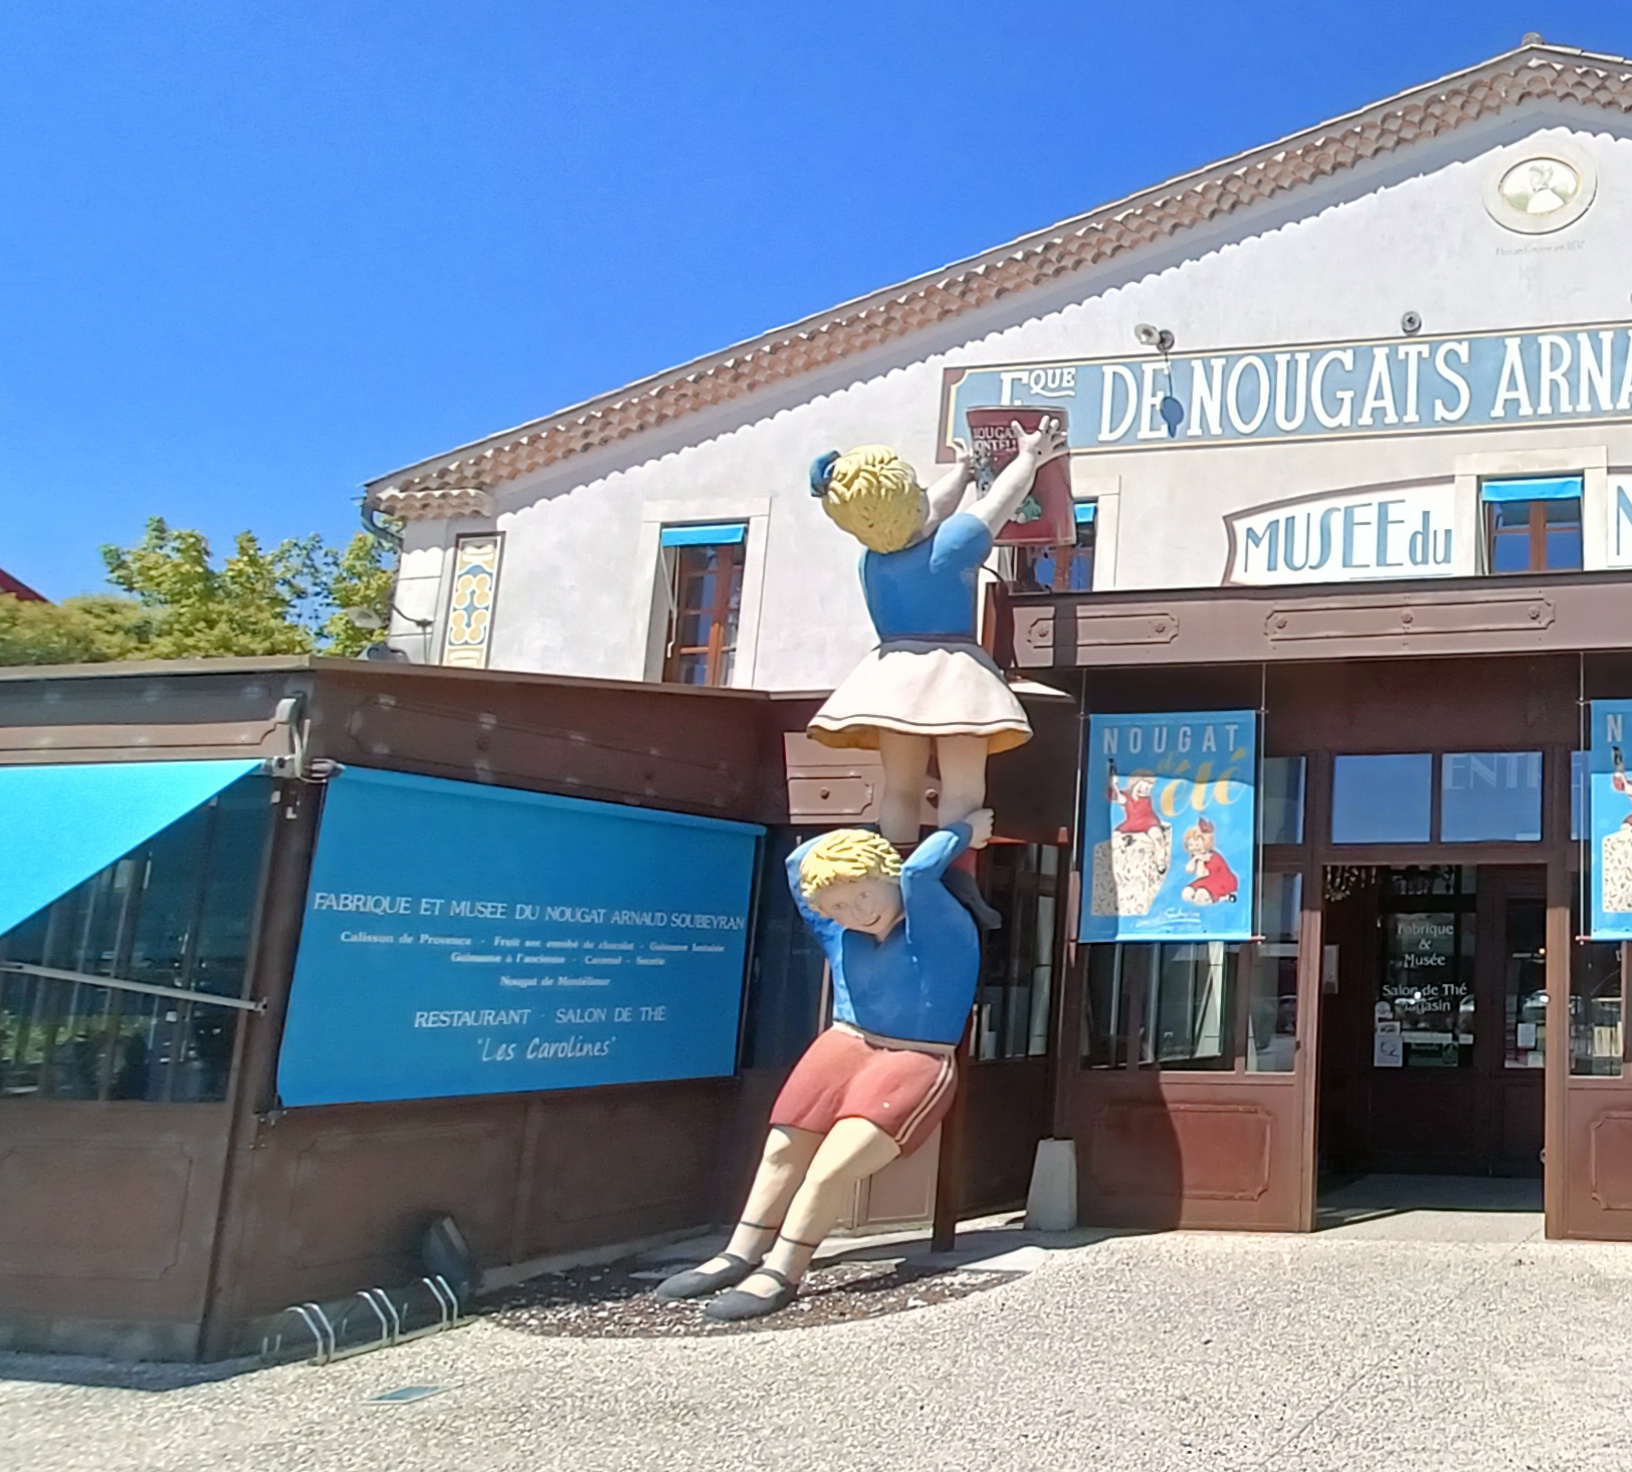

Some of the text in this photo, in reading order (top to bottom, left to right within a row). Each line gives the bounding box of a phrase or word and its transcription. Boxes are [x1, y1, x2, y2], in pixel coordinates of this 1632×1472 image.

[1098, 362, 1172, 441] DE
[1187, 340, 1471, 436] NOUGATS
[1243, 499, 1407, 574] MUSEE
[1408, 510, 1453, 567] du
[1103, 724, 1240, 755] NOUGAT
[313, 892, 745, 930] FABRIQUE ET MUSEE DU NOUGAT ARNAUD SOUBEYRAN
[340, 931, 394, 943] Calisson
[399, 933, 414, 944] de
[419, 934, 472, 945] Provence
[1397, 922, 1455, 936] Fabrique
[1418, 938, 1432, 950] &
[1403, 953, 1446, 968] Musée
[1422, 984, 1440, 996] de
[1442, 983, 1468, 996] Thé
[414, 1009, 532, 1028] RESTAURANT
[555, 1007, 607, 1024] SALON
[614, 1007, 633, 1023] DE
